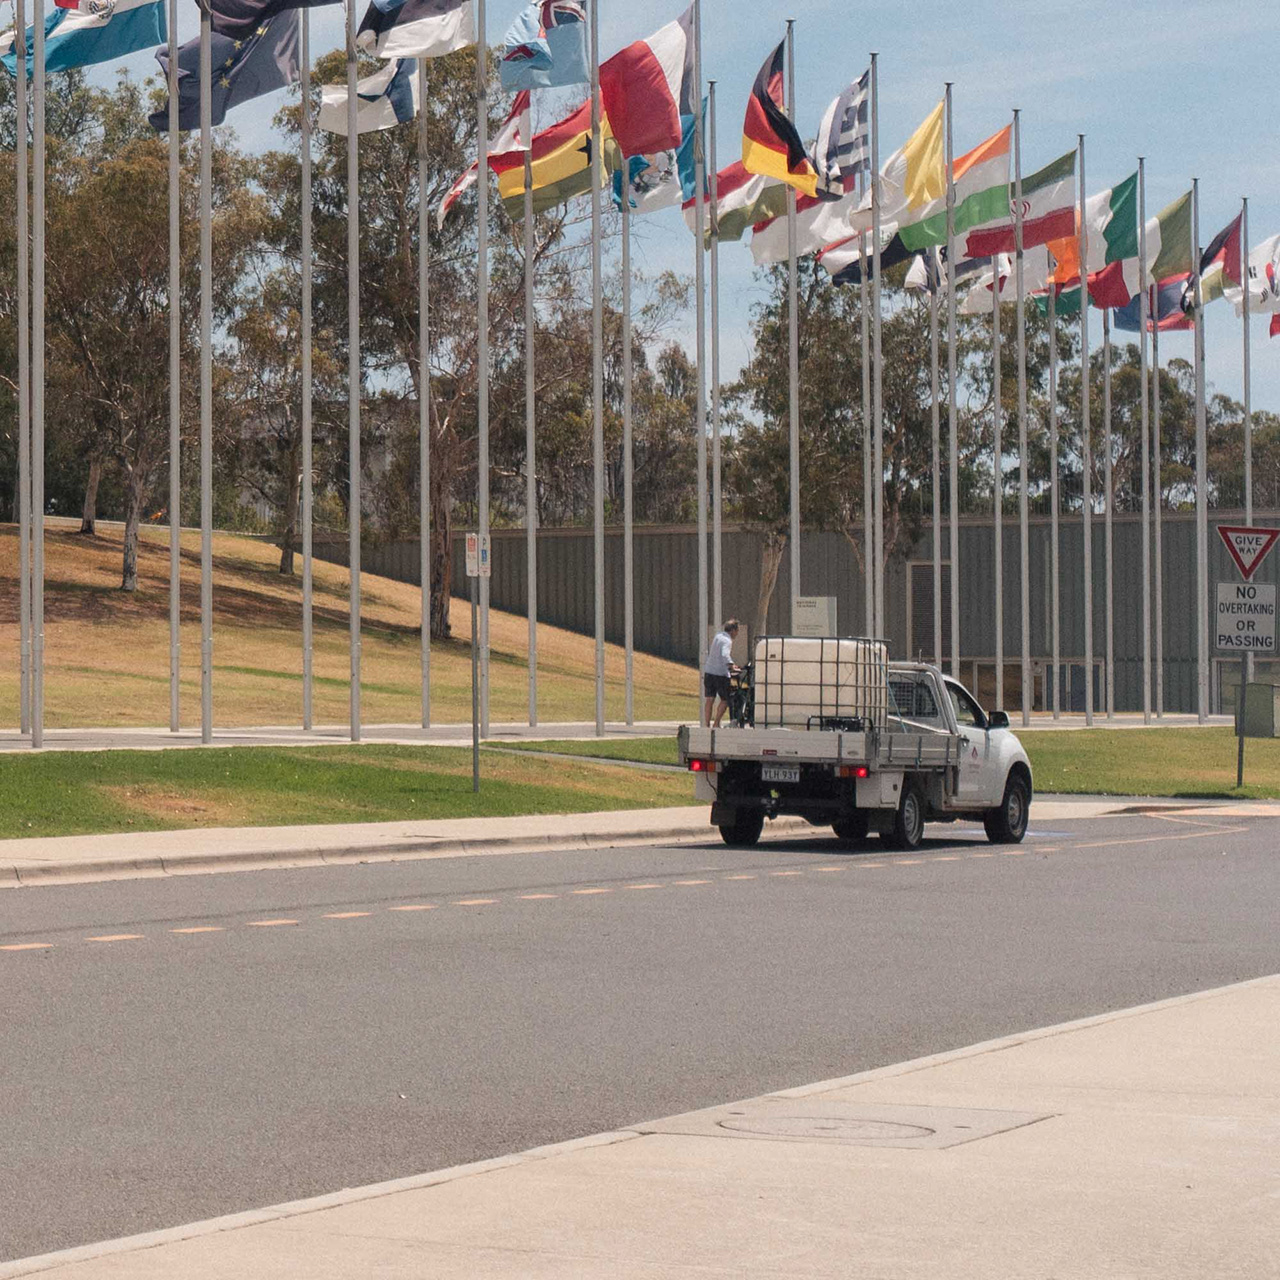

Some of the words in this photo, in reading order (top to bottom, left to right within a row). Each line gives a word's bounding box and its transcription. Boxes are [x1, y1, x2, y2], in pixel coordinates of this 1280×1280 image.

[1235, 536, 1263, 546] GIVE
[1239, 547, 1257, 555] WAY
[1236, 586, 1257, 599] NO
[1219, 602, 1274, 615] OVERTAKING
[1236, 620, 1256, 631] OR
[1218, 634, 1273, 647] PASSING
